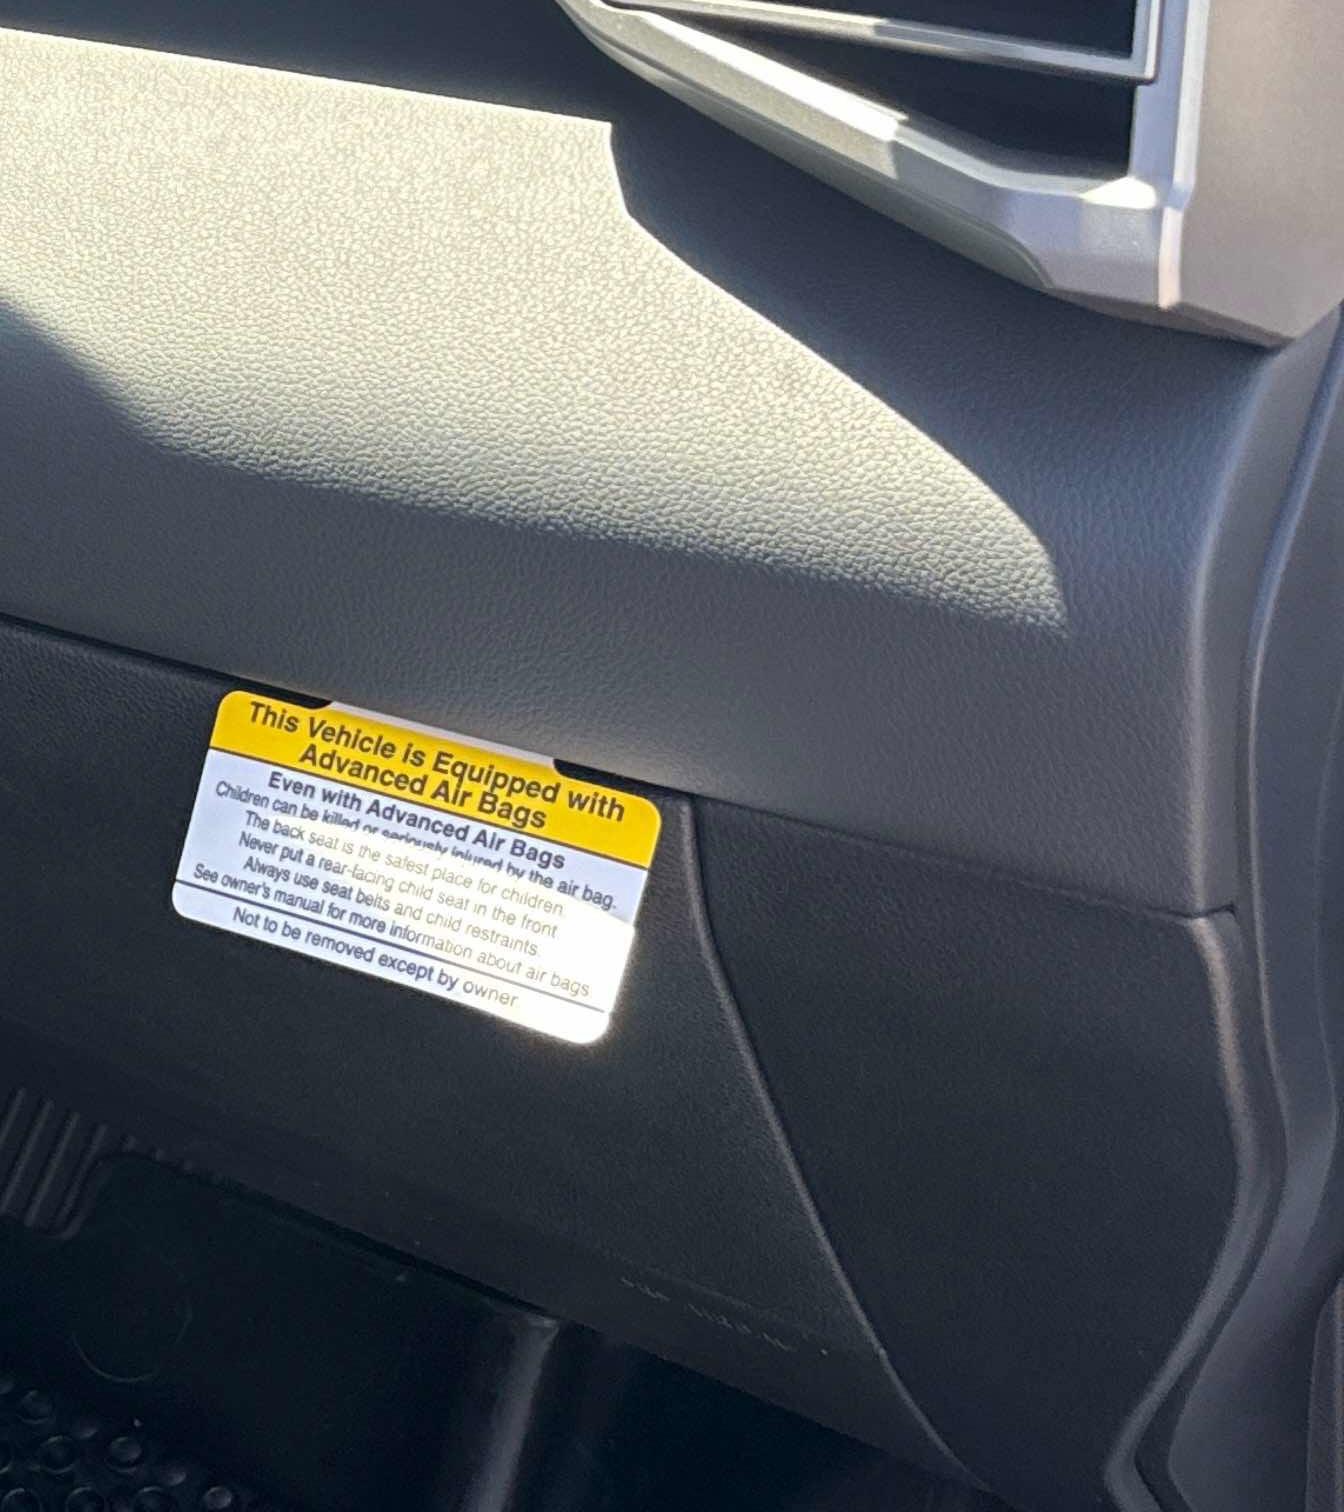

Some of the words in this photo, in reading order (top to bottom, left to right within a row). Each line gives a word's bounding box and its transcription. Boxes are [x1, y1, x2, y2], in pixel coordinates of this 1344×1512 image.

[250, 700, 299, 733] This
[308, 715, 396, 759] Vehicle
[401, 742, 426, 767] is
[431, 750, 561, 804] Equipped
[567, 789, 625, 822] with
[298, 742, 428, 796] Advanced
[429, 779, 473, 807] Air
[476, 790, 546, 829] Bags
[214, 779, 270, 808] Children
[271, 798, 298, 816] can
[299, 802, 319, 821] be
[320, 808, 361, 830] killed
[505, 860, 526, 879] by
[527, 869, 554, 889] the
[556, 879, 580, 897] air
[580, 883, 616, 912] bag.
[245, 809, 270, 831] The
[271, 818, 305, 840] back
[307, 831, 339, 850] seat
[340, 841, 354, 855] is
[357, 844, 381, 862] the
[384, 853, 430, 876] safest
[430, 867, 473, 889] place
[476, 877, 498, 894] for
[267, 770, 316, 799] Even
[321, 787, 362, 812] with
[364, 798, 470, 842] Advanced
[471, 828, 505, 851] Air
[508, 837, 565, 870] Bags
[192, 862, 219, 884] See
[219, 873, 271, 899] owner's
[272, 889, 325, 914] manual
[326, 901, 346, 920] for
[347, 911, 386, 933] more
[388, 919, 472, 958] information
[475, 951, 522, 974] about
[524, 966, 547, 982] air
[238, 830, 279, 855] Never
[278, 845, 304, 863] put
[304, 853, 315, 867] a
[316, 856, 394, 893] rear-facing
[397, 880, 434, 901] child
[436, 891, 470, 911] seat
[472, 903, 487, 916] in
[491, 905, 517, 926] the
[242, 855, 291, 883] Always
[292, 872, 319, 890] use
[320, 880, 353, 901] seat
[354, 887, 390, 911] belts
[392, 902, 423, 921] and
[425, 911, 462, 933] child
[232, 905, 261, 928] Not
[262, 915, 278, 933] to
[280, 920, 302, 940] be
[304, 930, 376, 963] removed
[377, 953, 434, 981] except
[436, 967, 459, 992] by
